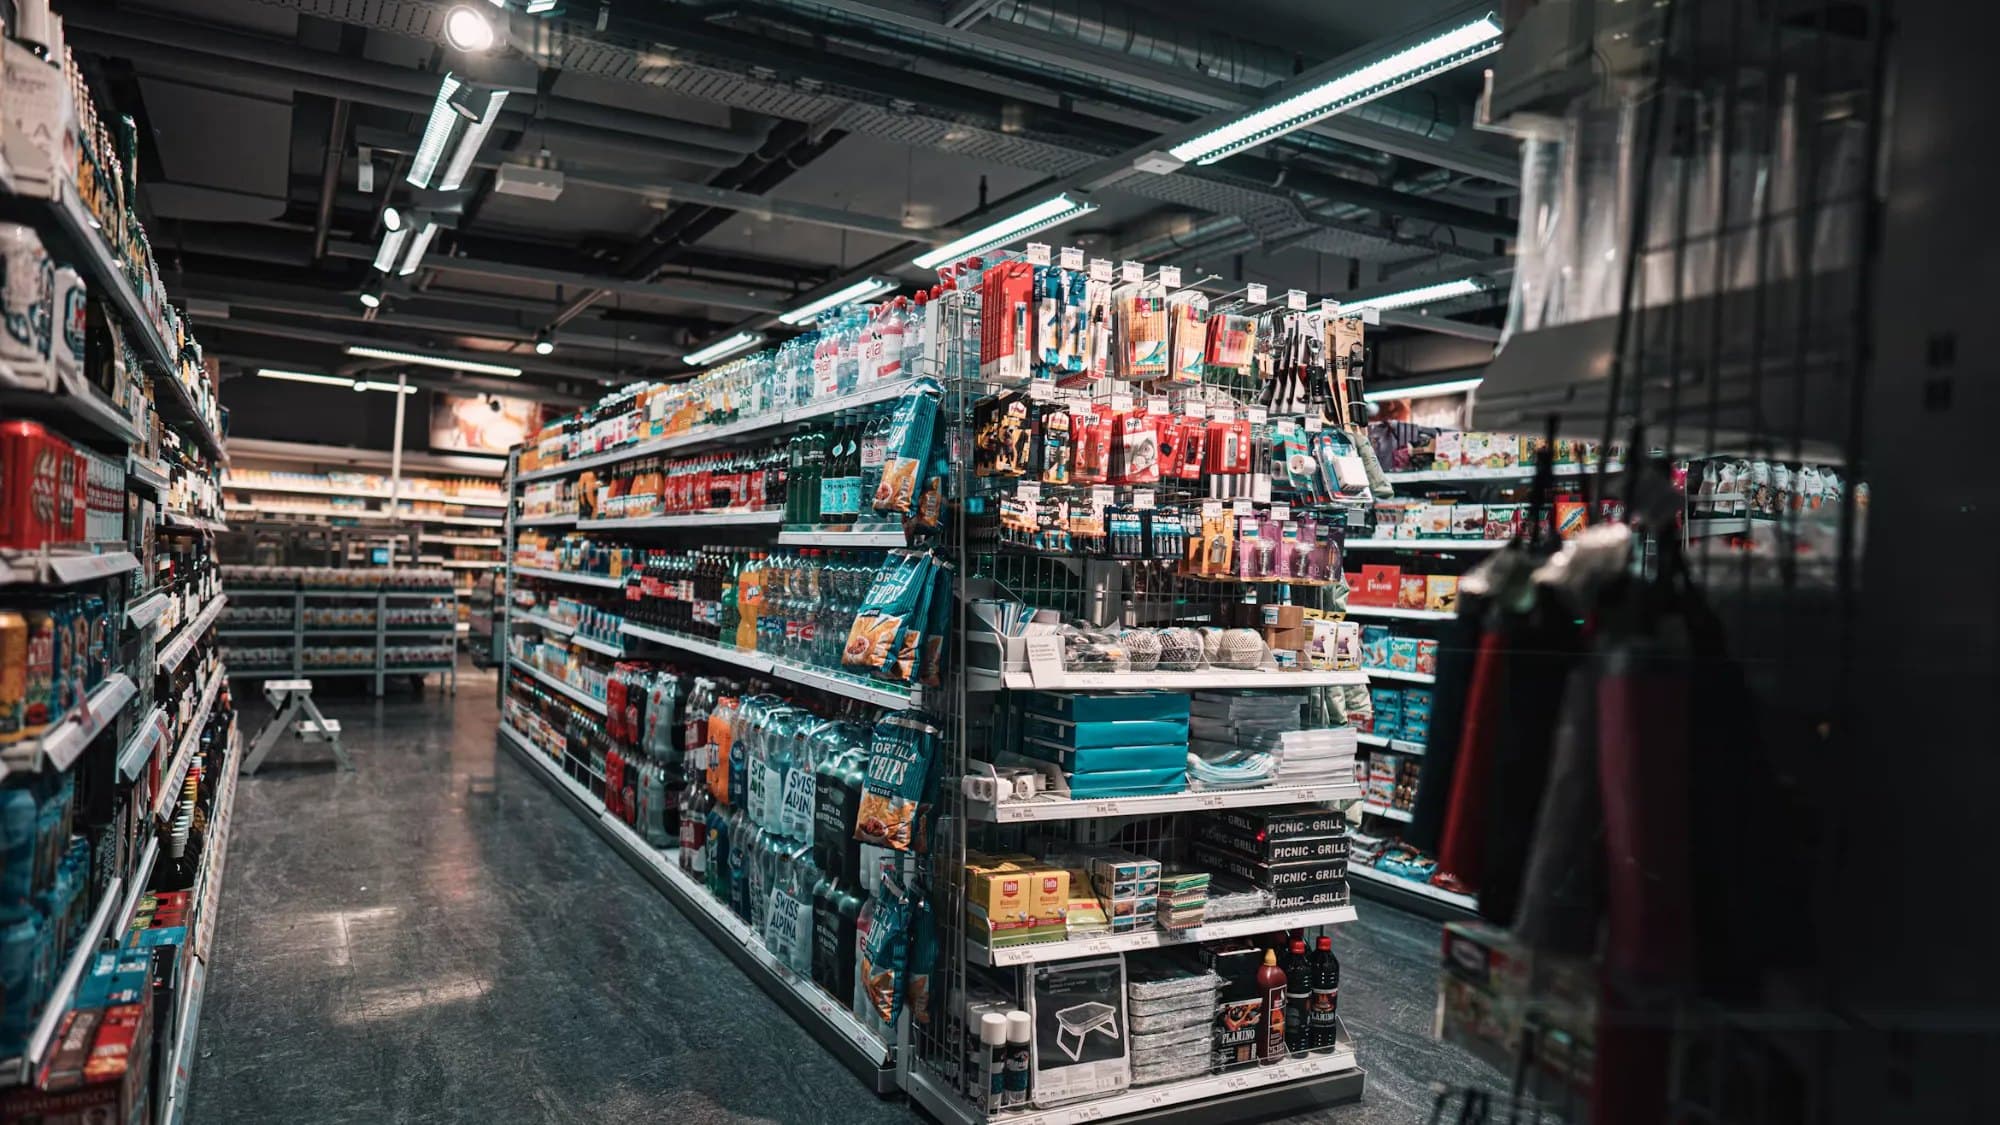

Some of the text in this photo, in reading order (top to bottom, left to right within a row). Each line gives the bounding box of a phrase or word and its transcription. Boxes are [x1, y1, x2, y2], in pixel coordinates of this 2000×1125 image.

[871, 742, 917, 764] TORTILLA
[869, 755, 908, 786] CHIPS
[1268, 822, 1304, 834] PICNIC
[1312, 819, 1342, 831] GRILL
[1274, 846, 1309, 858] PICNIC
[1317, 843, 1346, 855] GRILL
[1273, 871, 1307, 884] PICNIC
[1315, 868, 1344, 880] GRILL
[774, 891, 799, 921] SWISS
[1270, 895, 1304, 909] PICNIC
[1312, 892, 1341, 904] GRILL
[769, 911, 797, 942] ALPINA
